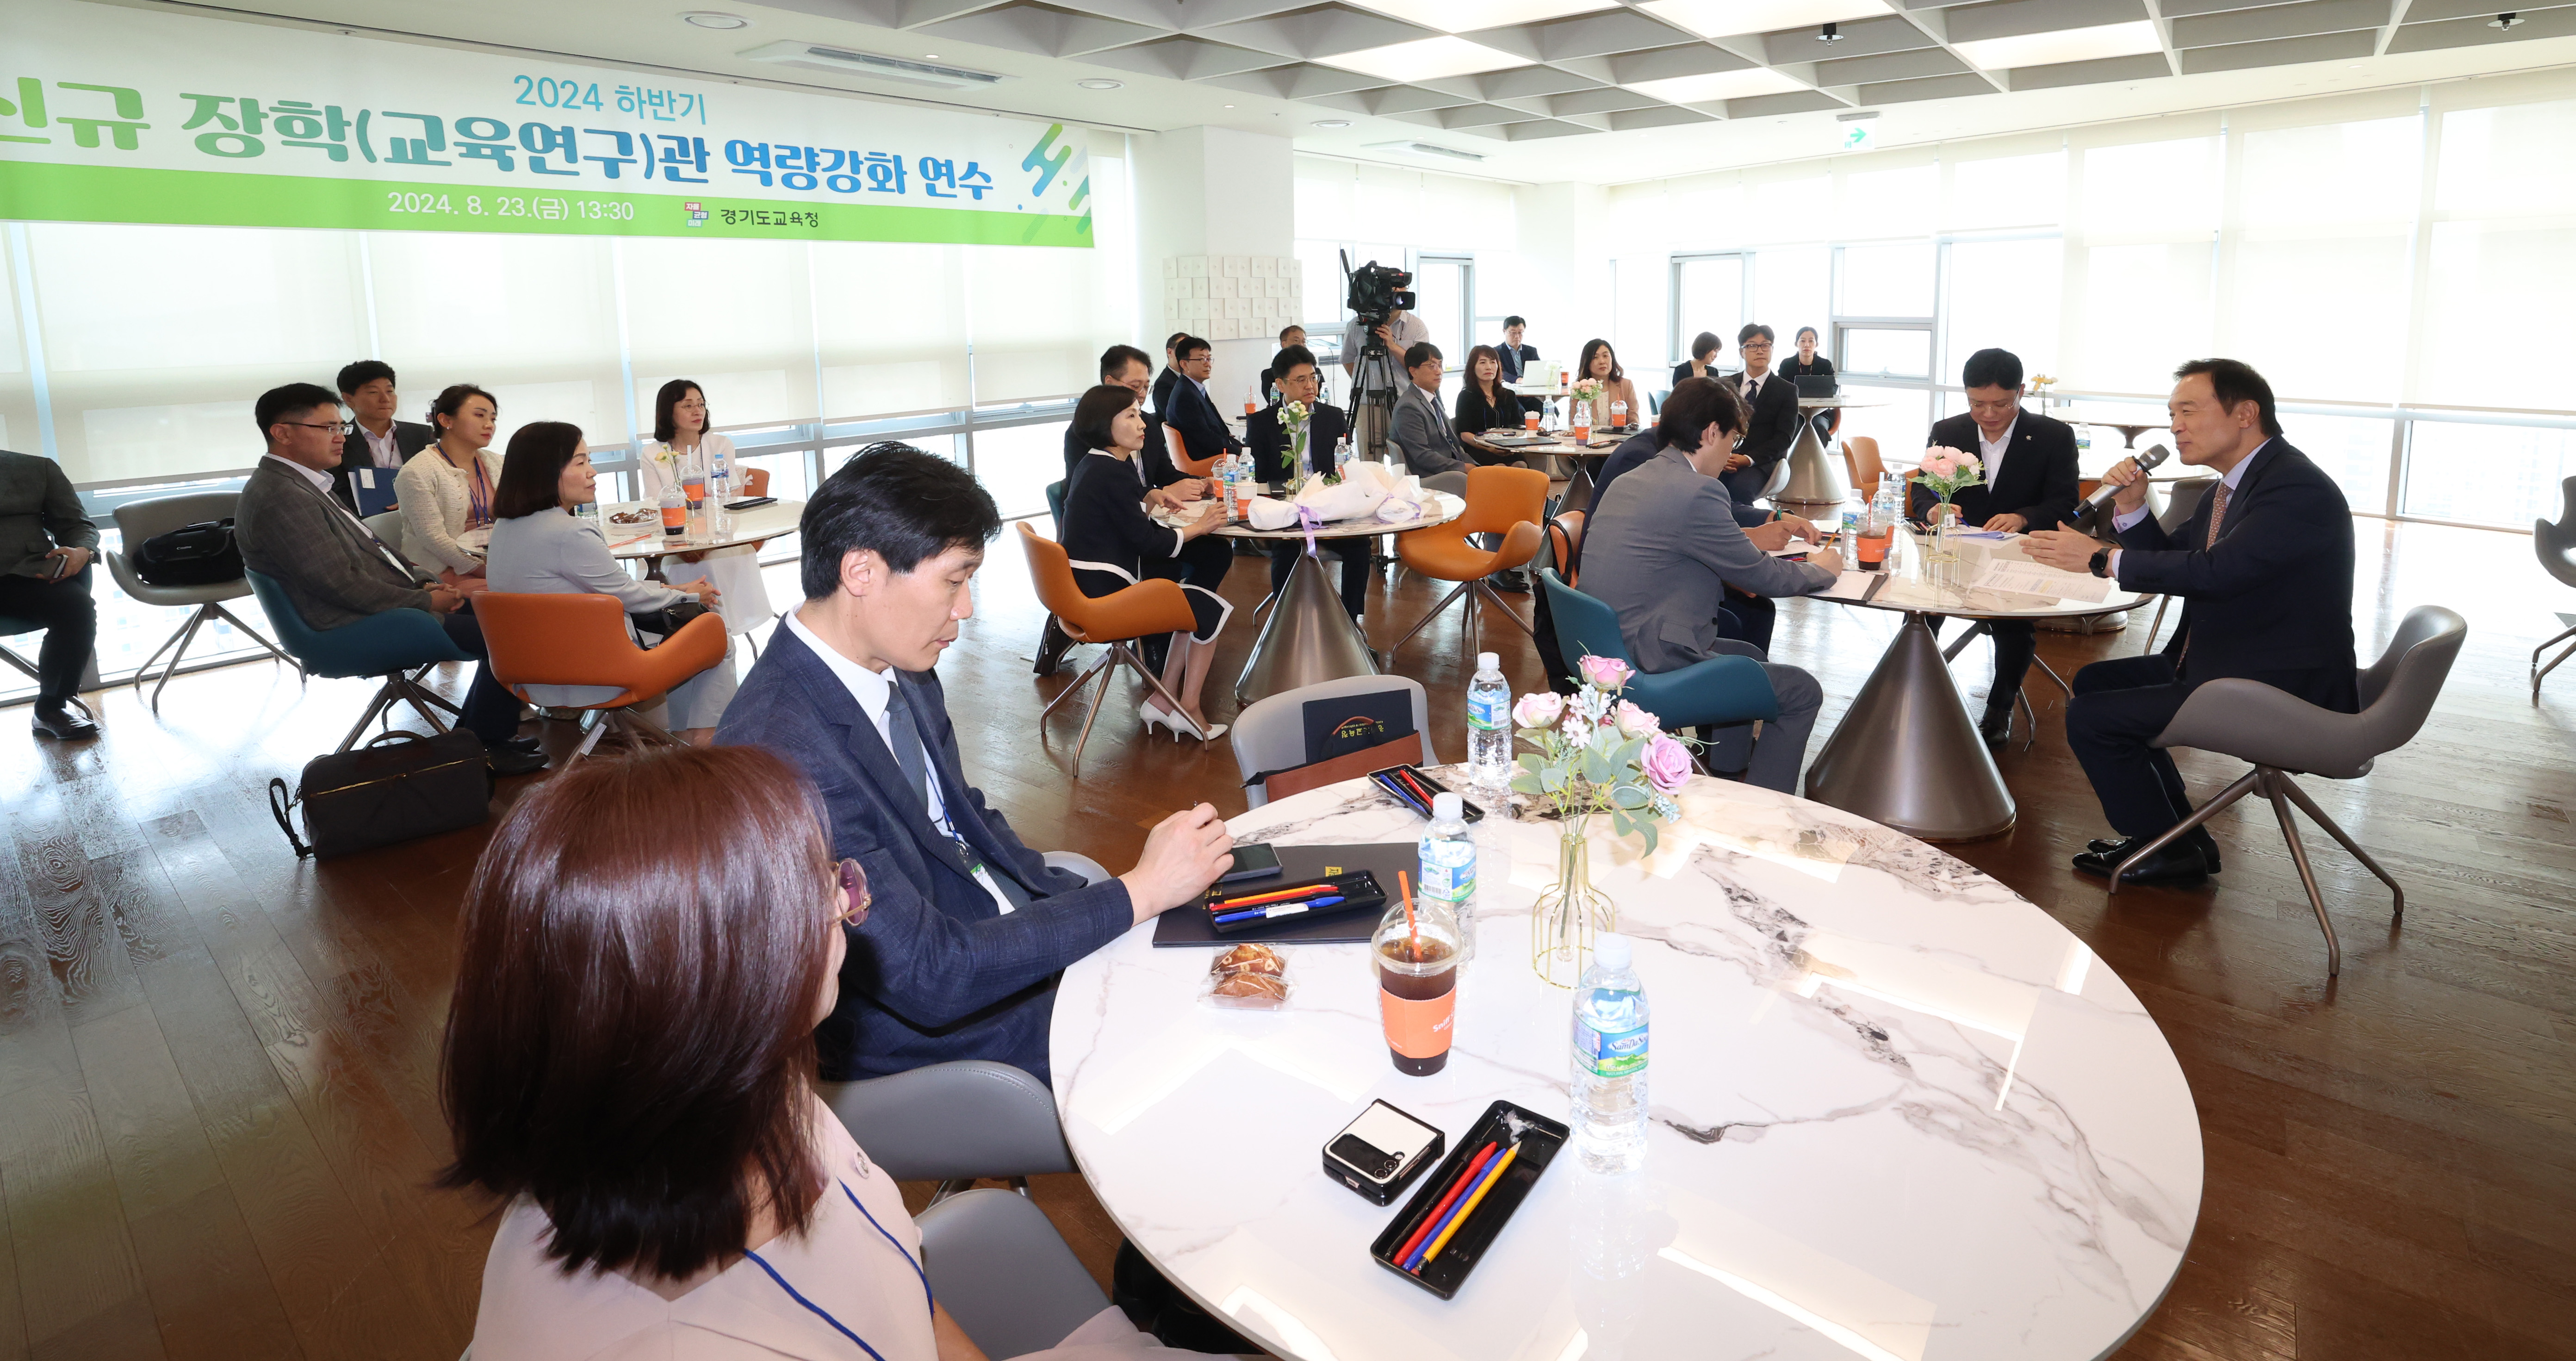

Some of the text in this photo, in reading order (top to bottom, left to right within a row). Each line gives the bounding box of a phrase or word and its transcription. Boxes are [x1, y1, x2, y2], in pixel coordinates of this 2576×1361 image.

[514, 75, 707, 125] 2024 하반기
[180, 93, 711, 184] 장학(교육연구)관
[725, 139, 908, 195] 역량강화
[919, 156, 993, 200] 연수
[388, 192, 634, 221] 2024. 8. 23.(금) 13:30
[720, 209, 819, 228] 경기도교육청
[1433, 1014, 1451, 1032] Sniff
